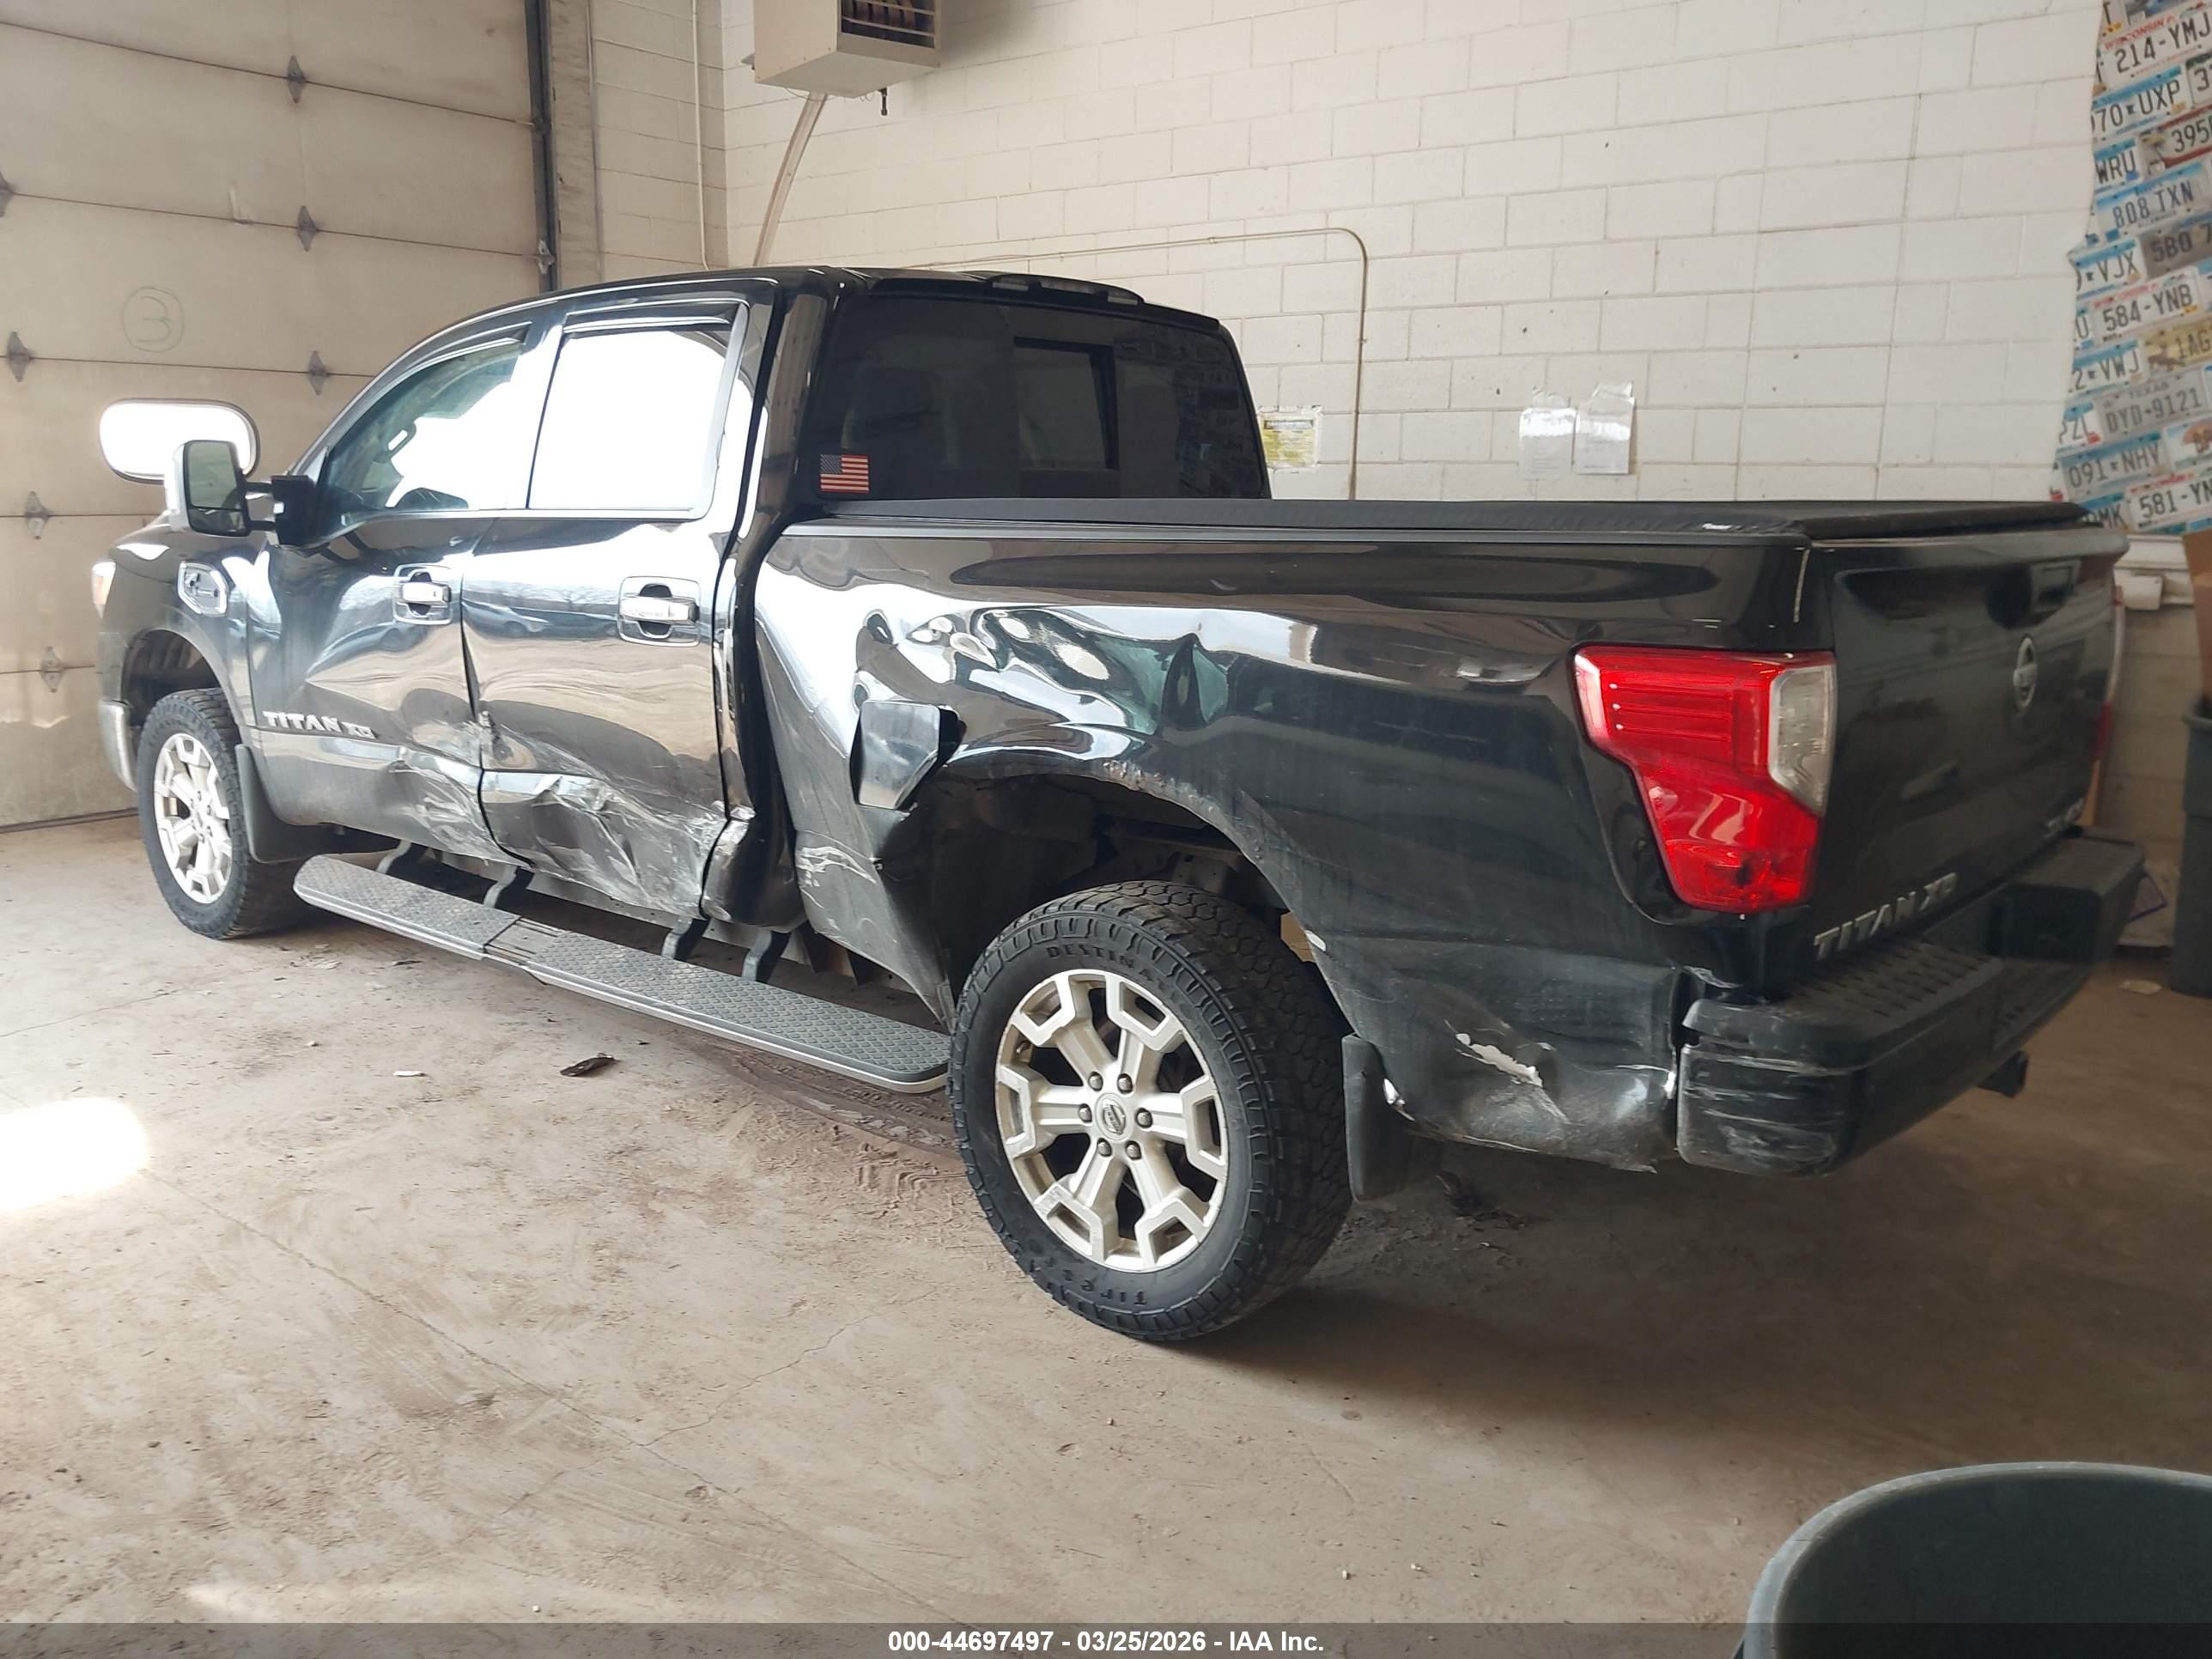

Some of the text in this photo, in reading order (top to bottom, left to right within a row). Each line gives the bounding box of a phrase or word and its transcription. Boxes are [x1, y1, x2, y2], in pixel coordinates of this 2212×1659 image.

[2114, 11, 2211, 74] 214-YMJ
[2113, 197, 2151, 228] 808
[2154, 179, 2194, 212] TXN
[2103, 283, 2193, 331] 584-YNB
[2069, 459, 2109, 489] 091
[262, 710, 342, 732] TITAN
[1814, 890, 1917, 962] TITAN
